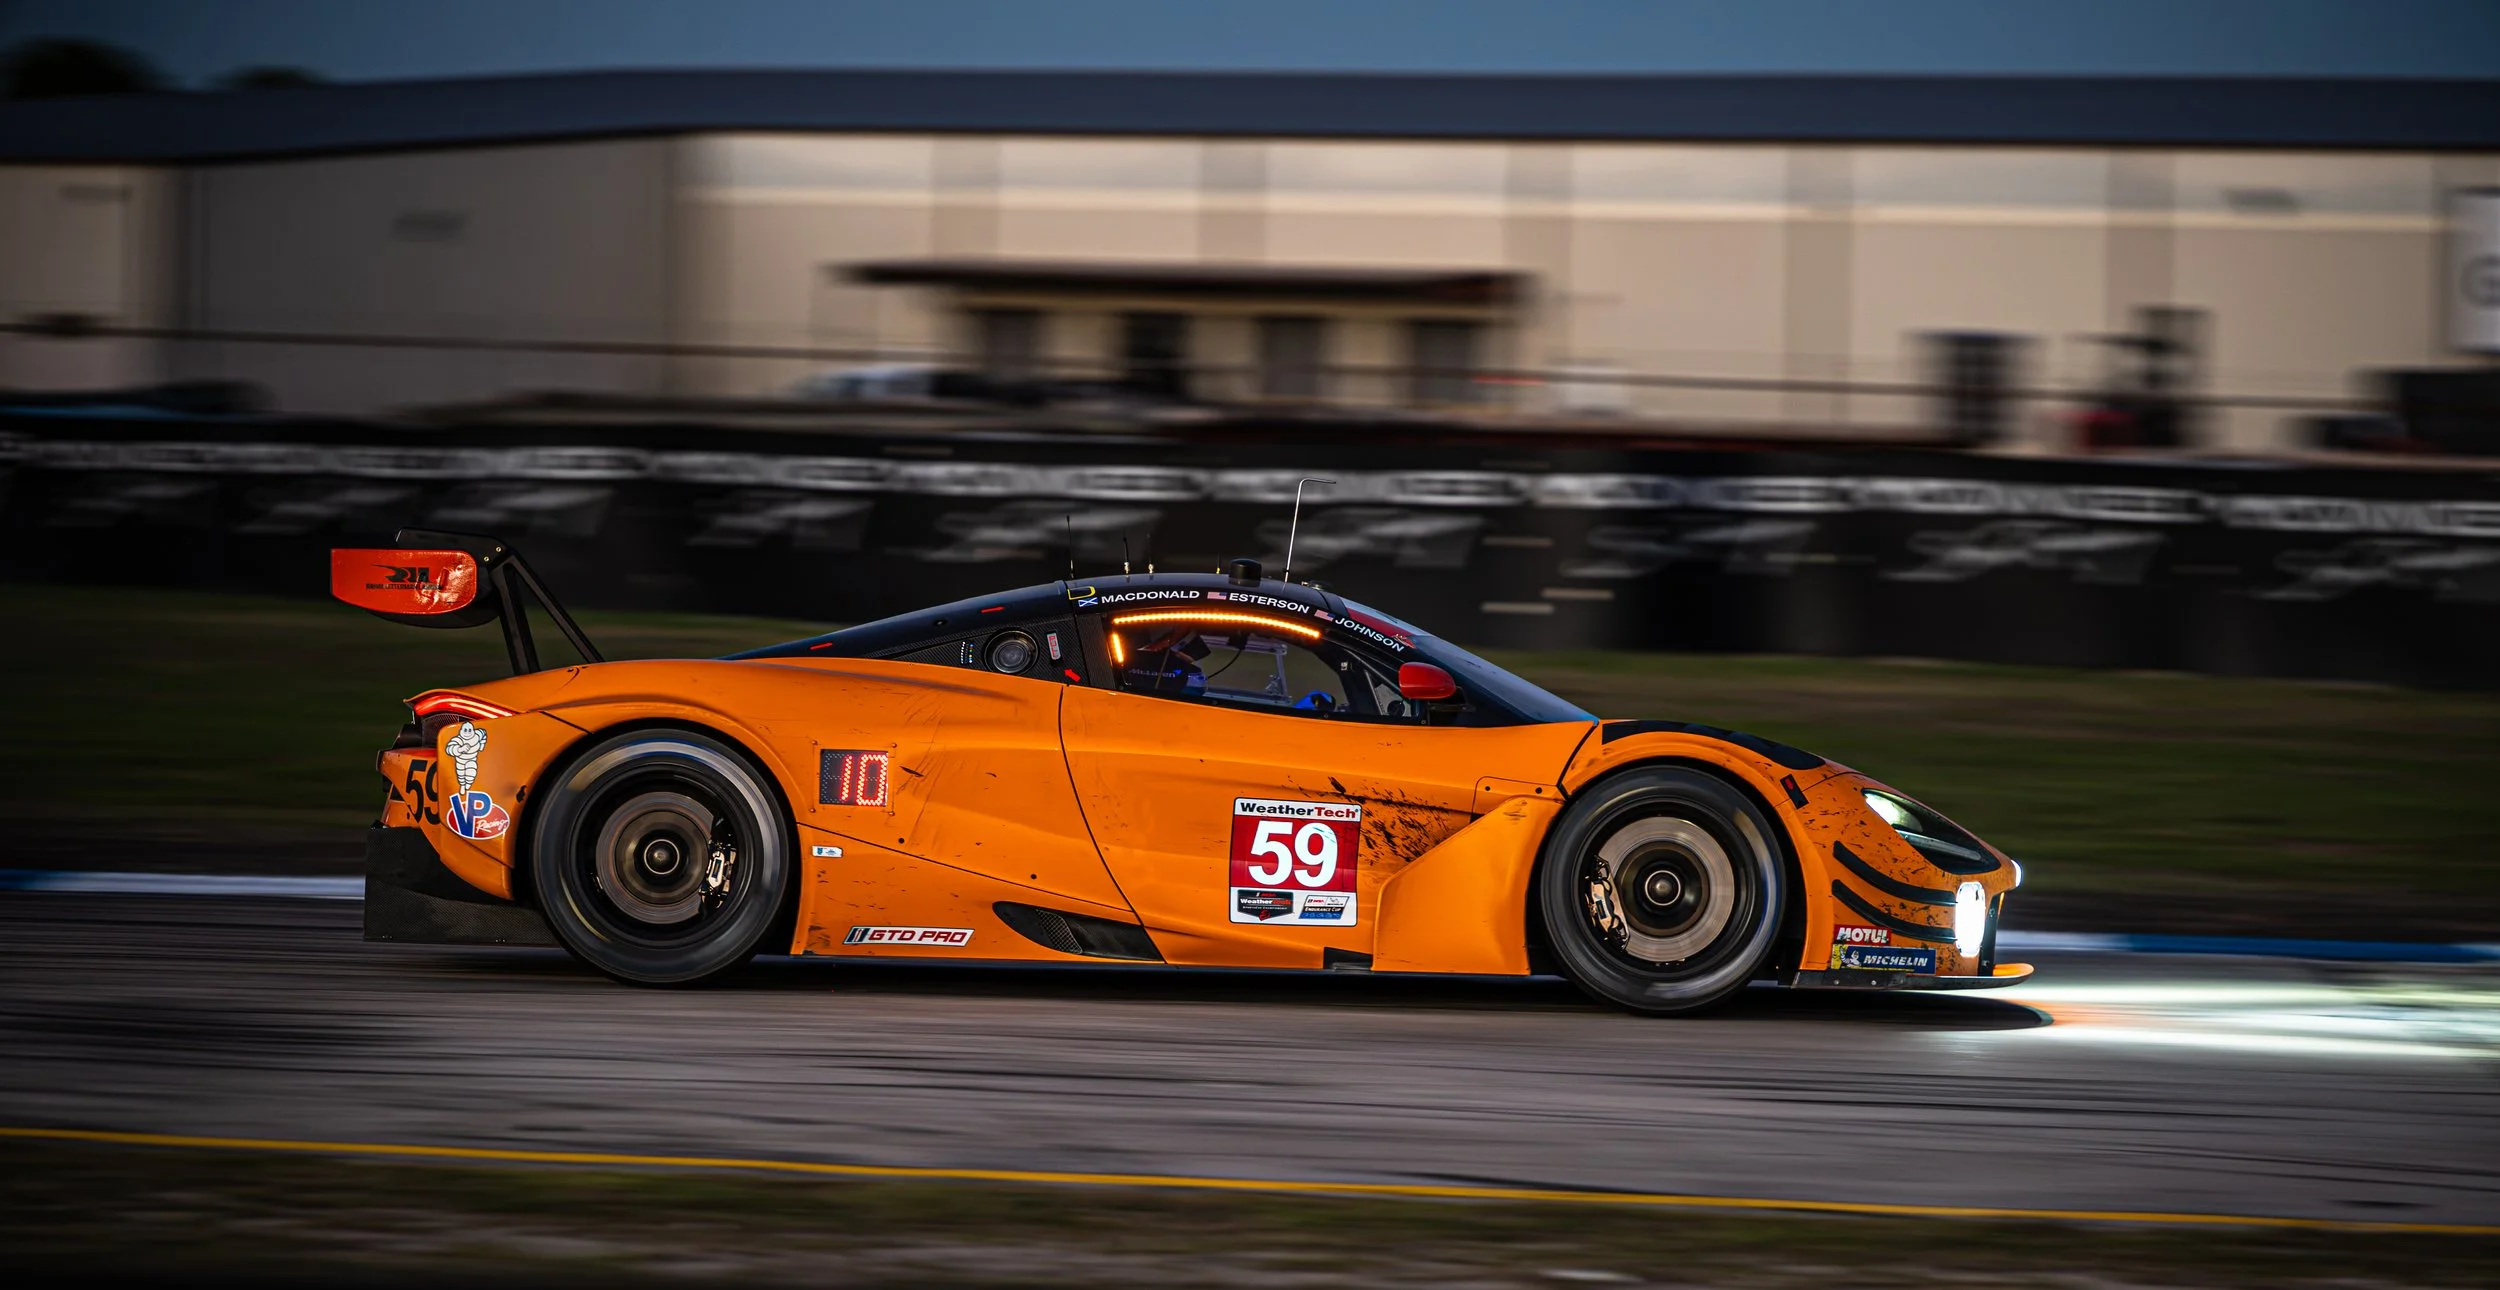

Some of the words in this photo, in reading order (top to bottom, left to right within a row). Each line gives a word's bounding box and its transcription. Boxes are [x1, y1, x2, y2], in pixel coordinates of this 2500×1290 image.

[1101, 590, 1200, 604] MACDONALD
[1229, 592, 1310, 614] ESTERSON
[1335, 617, 1405, 652] JOHNSON
[840, 754, 888, 806] 10
[405, 759, 440, 825] 59
[449, 791, 492, 838] VP
[1240, 802, 1357, 819] WeatherTech
[475, 818, 509, 834] Racing
[1248, 820, 1338, 888] 59
[868, 930, 916, 941] GTD
[918, 930, 968, 943] PRO
[1836, 927, 1889, 943] MOTUL
[1863, 955, 1928, 967] MICHELIN
